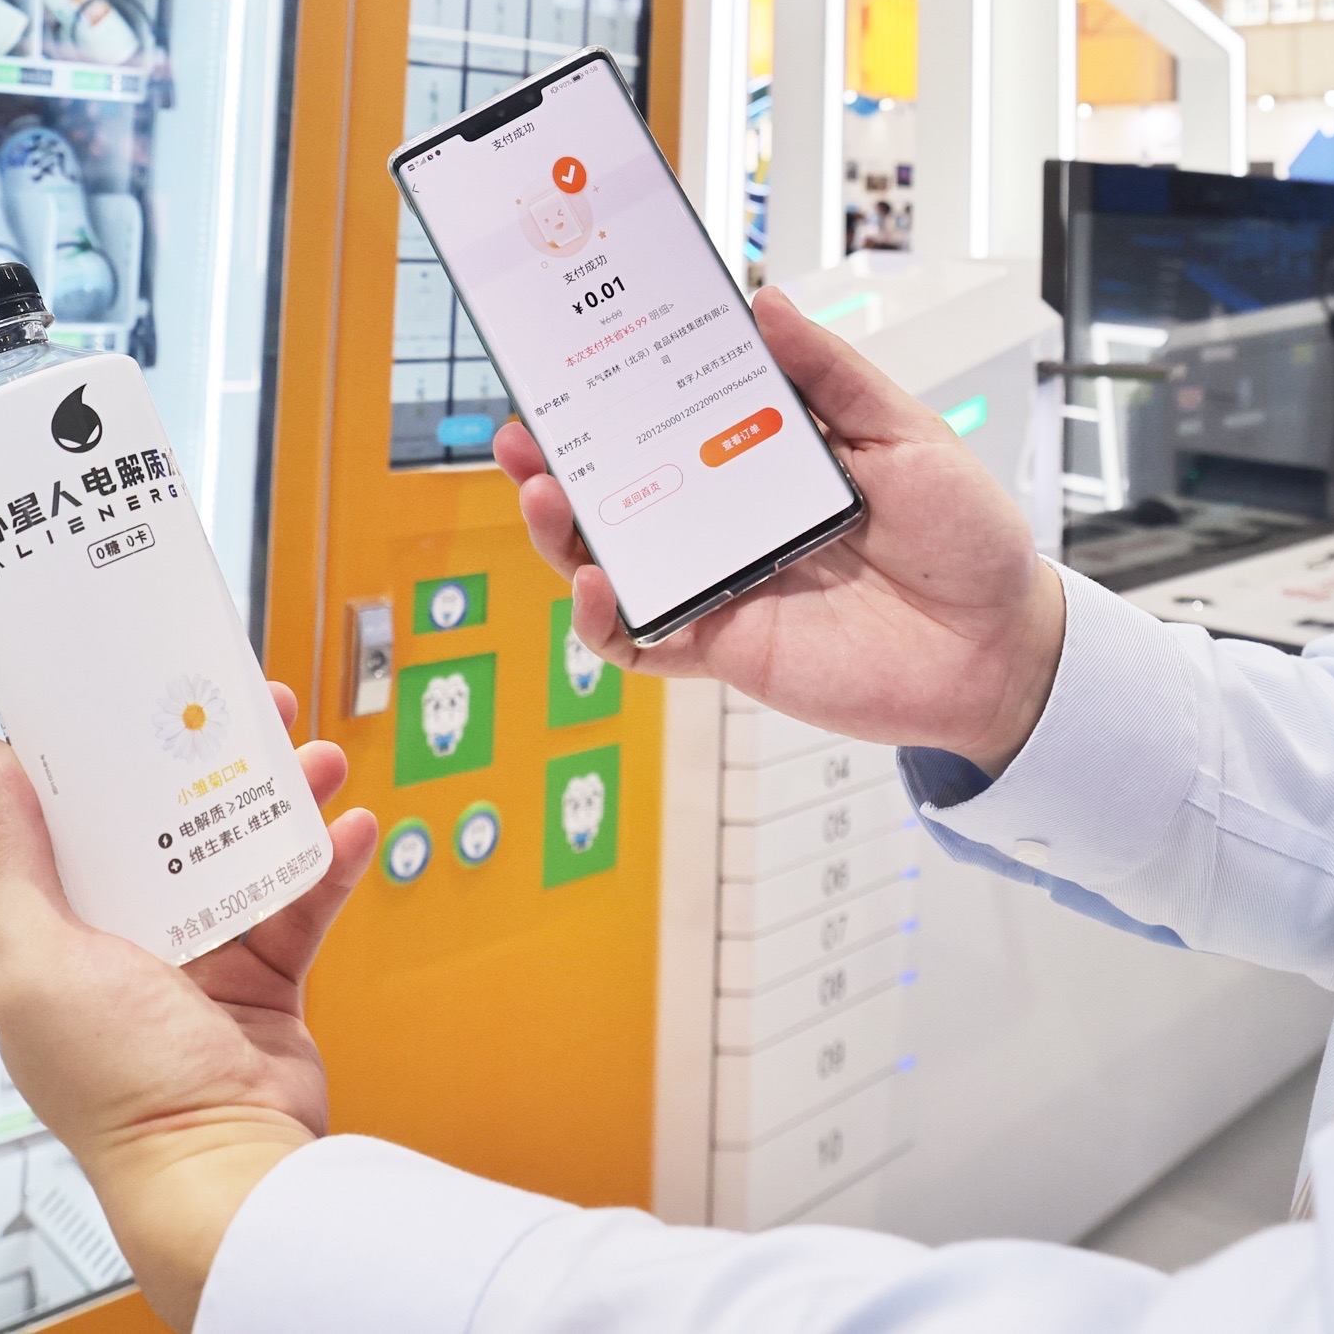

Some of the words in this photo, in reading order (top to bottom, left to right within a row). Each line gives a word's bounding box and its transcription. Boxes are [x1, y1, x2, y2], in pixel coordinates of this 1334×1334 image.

[491, 121, 536, 151] 支付成功
[562, 254, 608, 286] 支付成功
[565, 316, 648, 368] 本次支付共省¥5.99
[660, 354, 672, 365] 司
[675, 340, 753, 390] 数字人民币主扫支付
[534, 392, 571, 418] 商户名称
[554, 432, 592, 459] 支付方式
[721, 423, 761, 453] 查看订单
[568, 462, 596, 484] 订单号
[621, 481, 661, 509] 返回首页
[95, 540, 121, 560] 0糖
[126, 529, 148, 547] 0卡
[177, 758, 250, 806] 小雏菊口味
[275, 842, 322, 886] 电解质饮料
